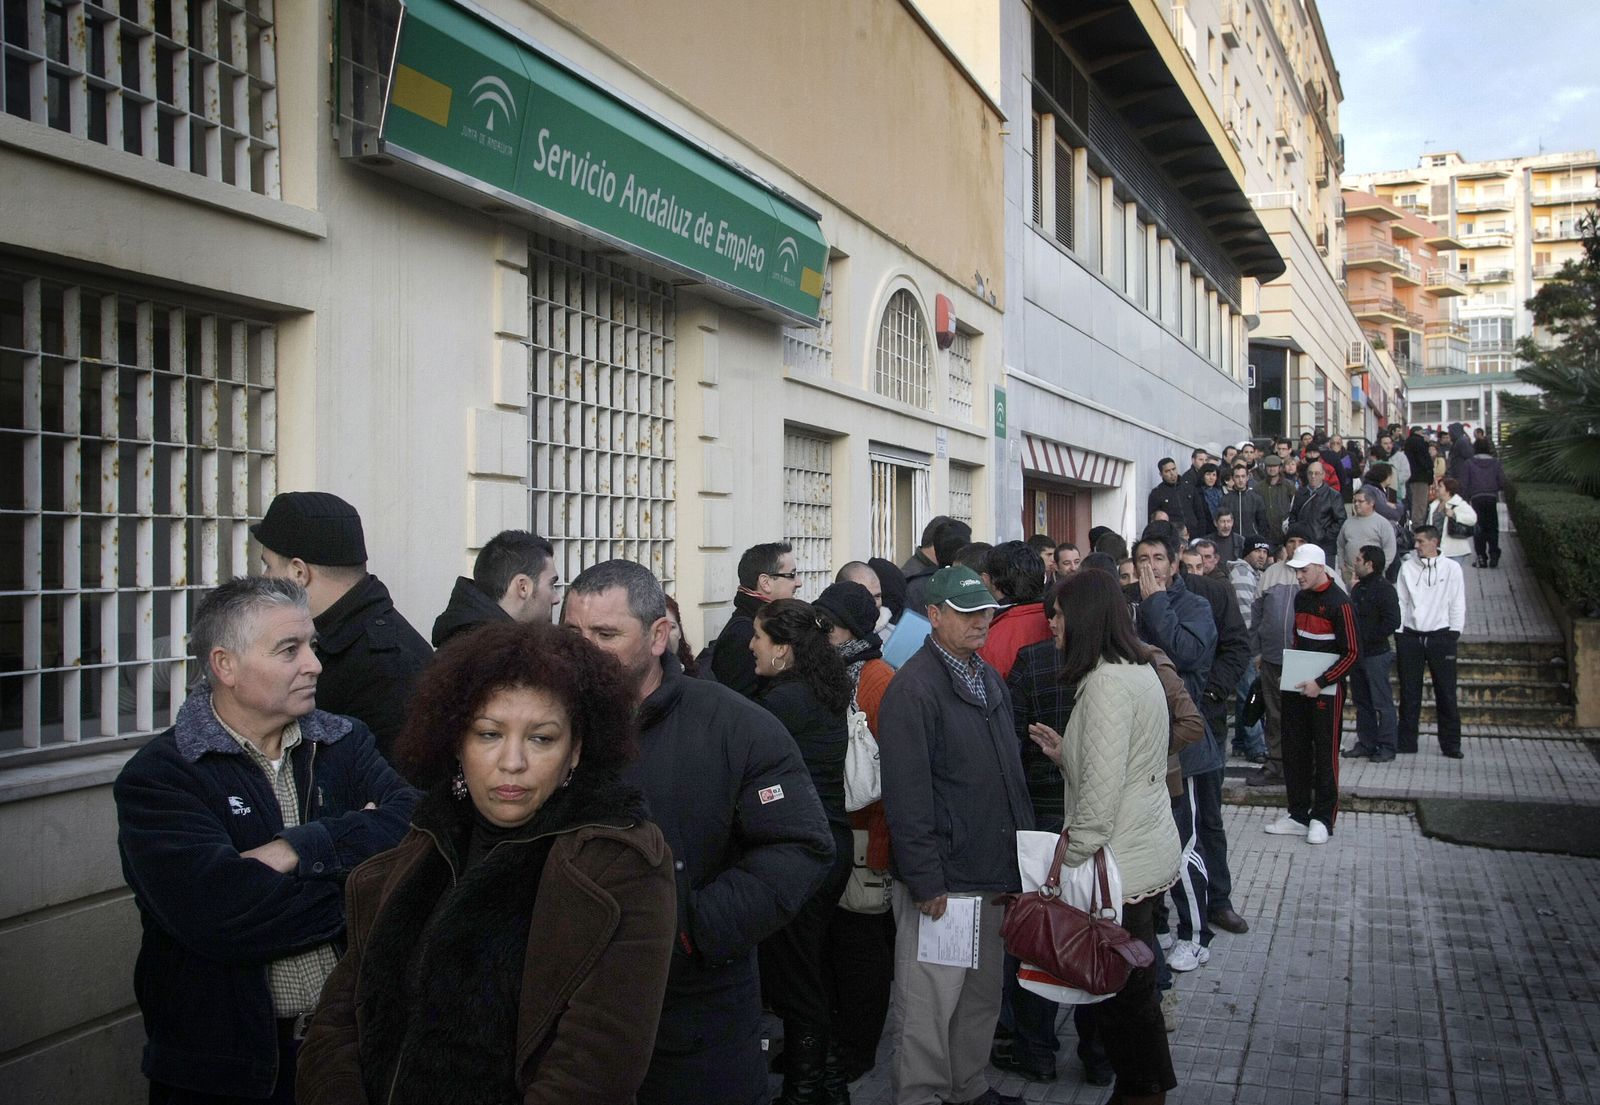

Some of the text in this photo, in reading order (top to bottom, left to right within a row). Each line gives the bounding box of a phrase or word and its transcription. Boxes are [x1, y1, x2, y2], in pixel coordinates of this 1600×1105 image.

[533, 128, 765, 273] Servicio Andaluz de Empleo
